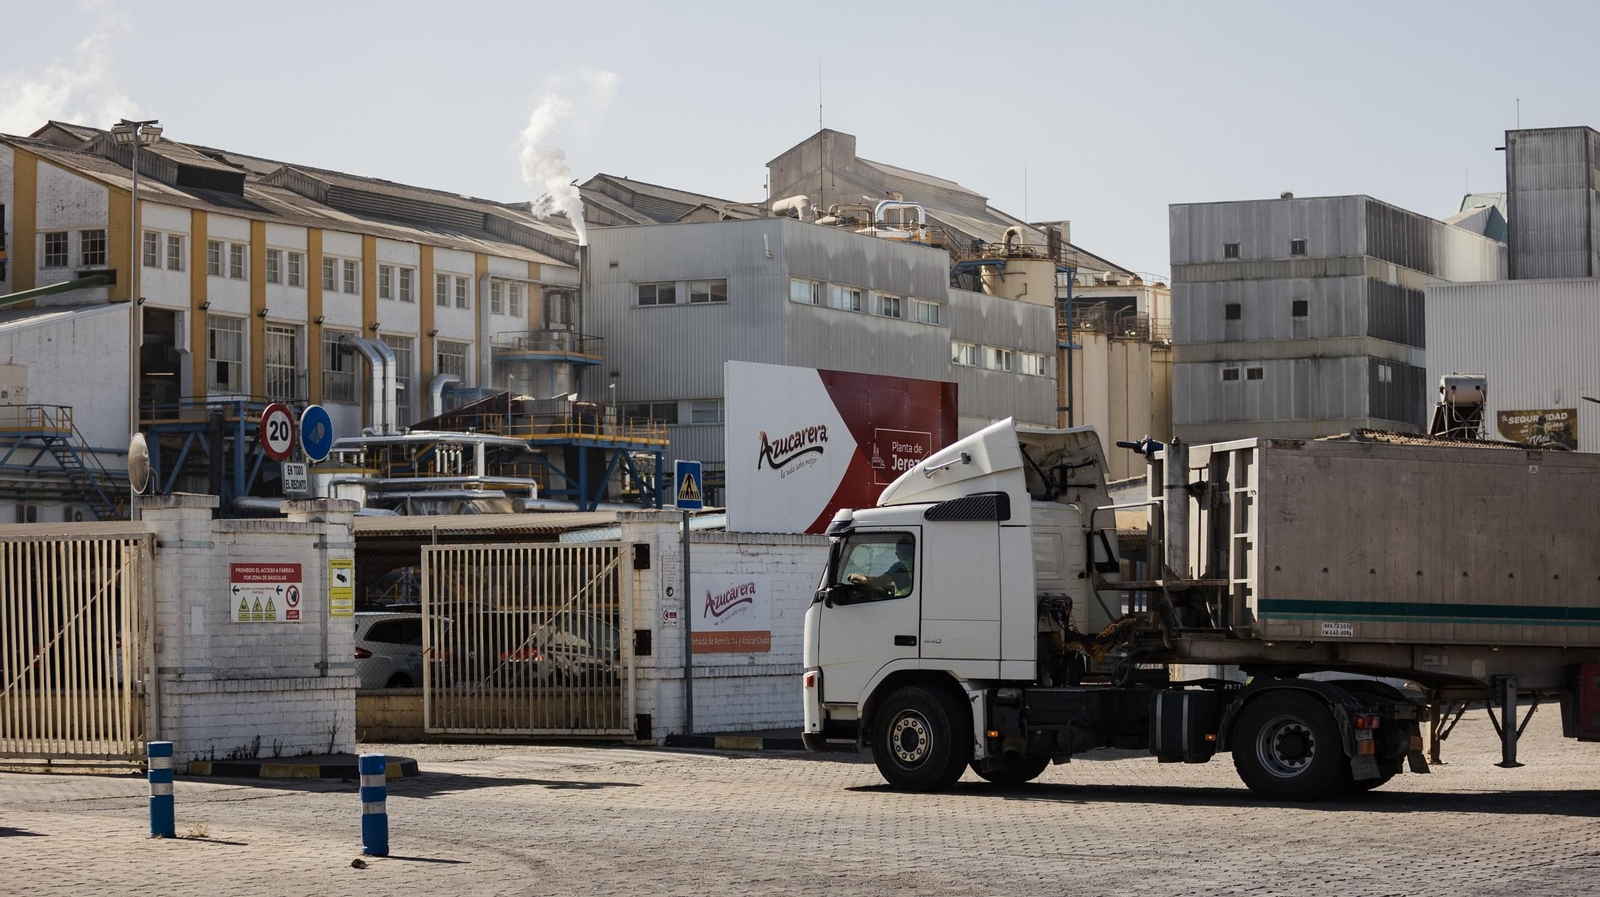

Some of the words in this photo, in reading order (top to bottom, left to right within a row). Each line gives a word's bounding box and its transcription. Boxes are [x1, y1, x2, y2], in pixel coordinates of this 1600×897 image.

[269, 420, 289, 441] 20
[758, 424, 829, 470] Azucarera
[891, 441, 913, 453] Planta
[913, 442, 923, 454] de
[287, 465, 293, 475] EN
[293, 465, 304, 476] TODO
[285, 479, 291, 489] EL
[291, 479, 307, 490] RECINTO
[704, 581, 756, 618] Azucarera
[708, 637, 714, 645] de
